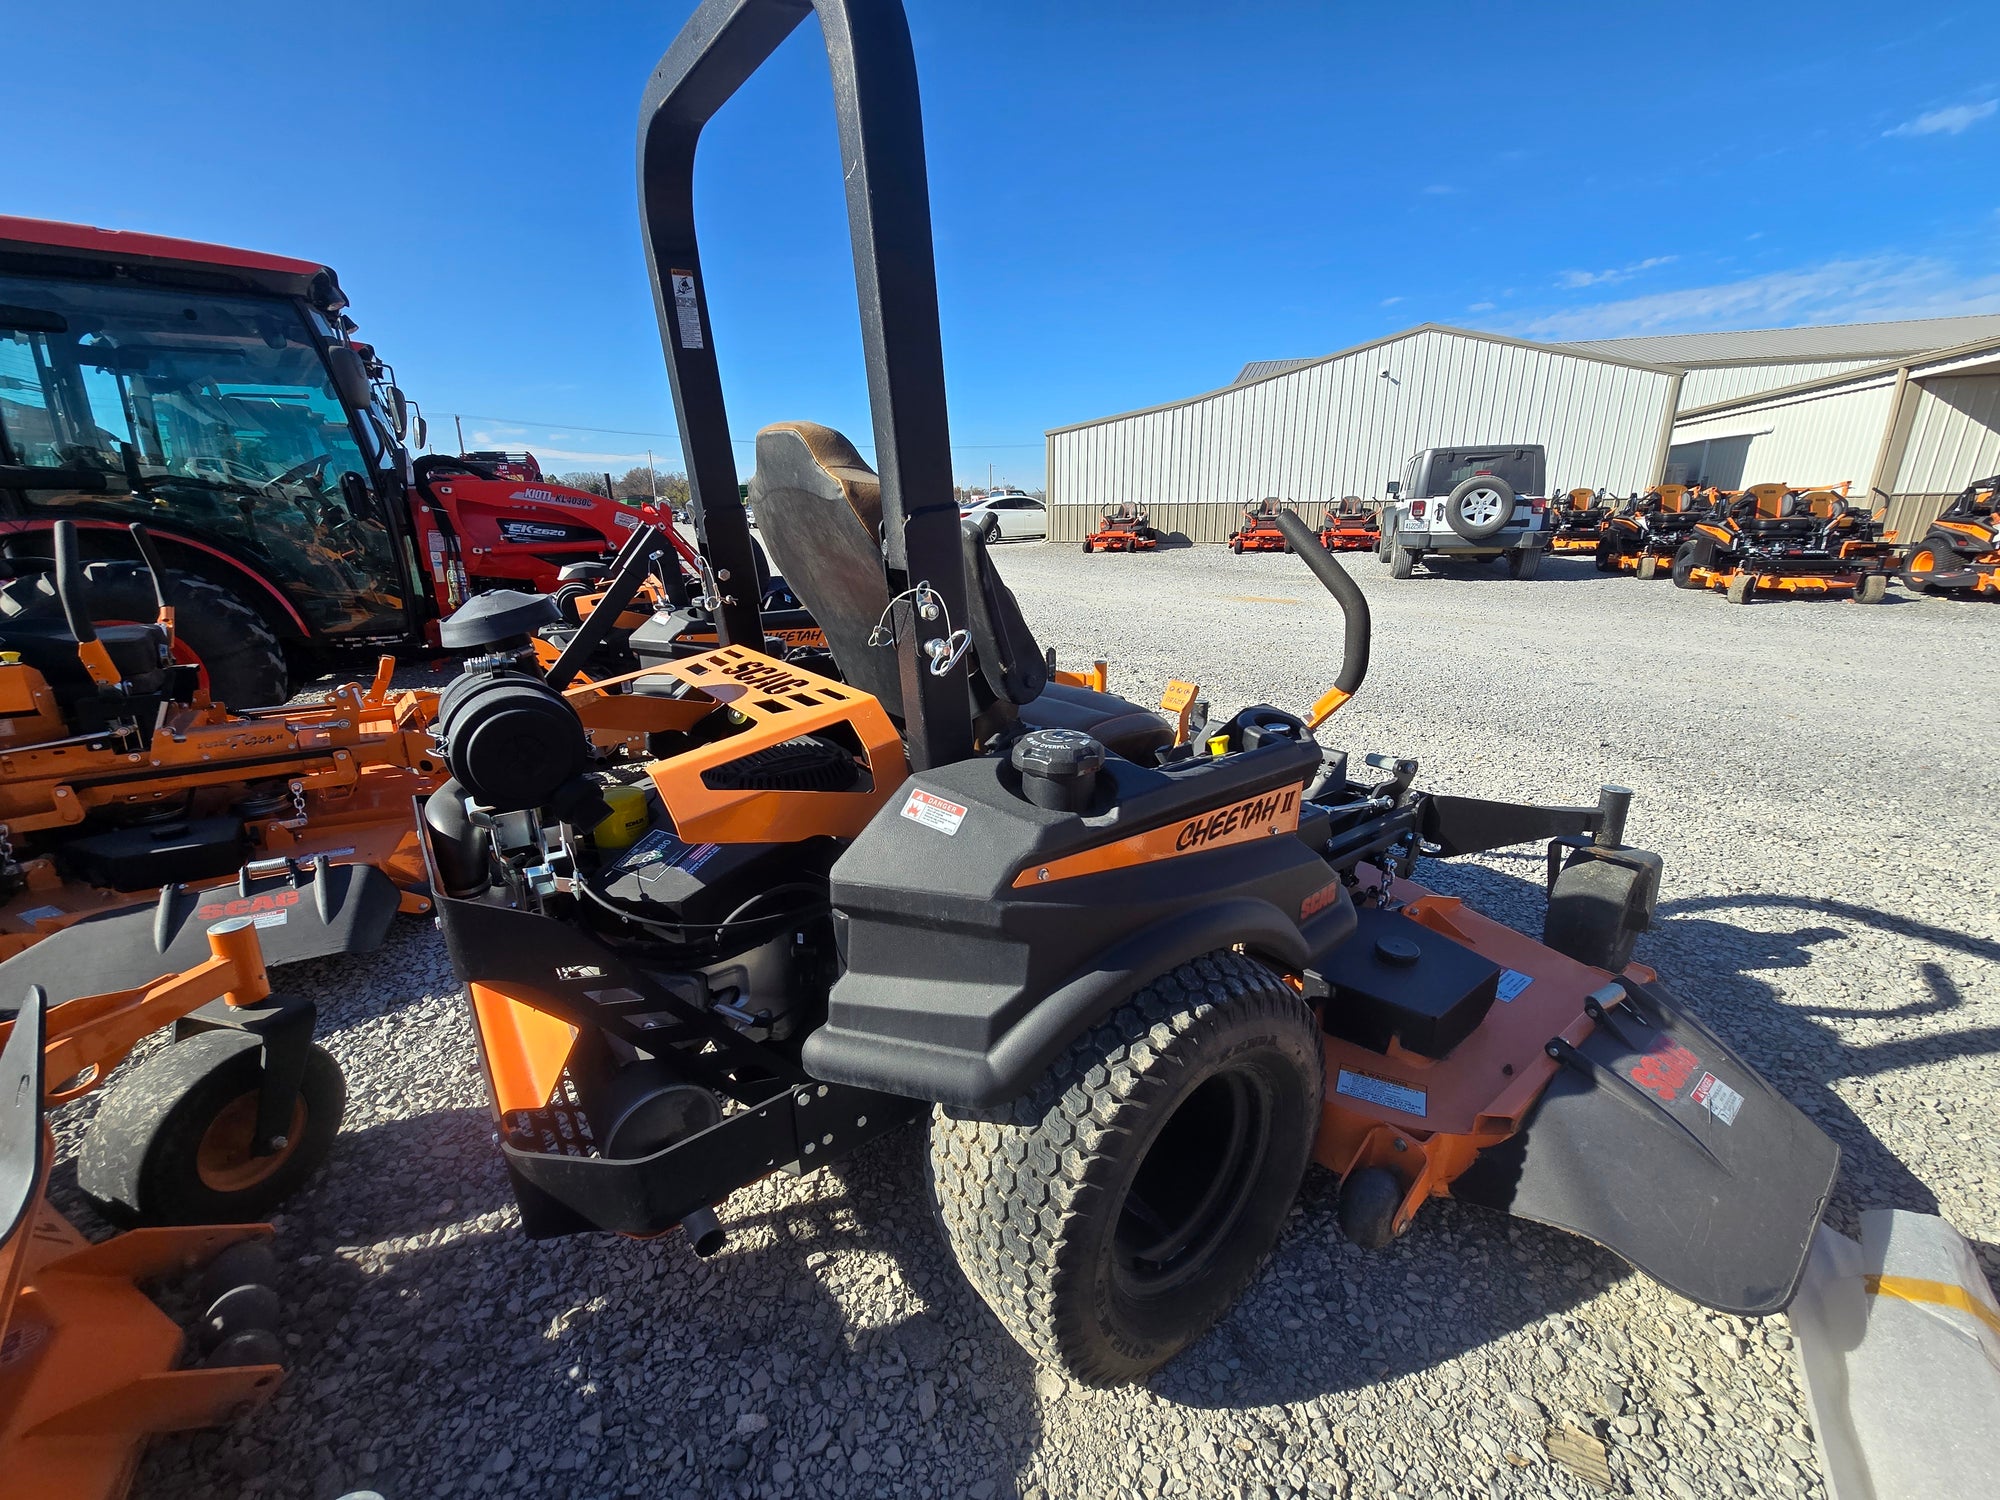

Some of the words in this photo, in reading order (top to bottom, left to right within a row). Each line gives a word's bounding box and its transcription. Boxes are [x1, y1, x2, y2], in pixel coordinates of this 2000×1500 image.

[525, 488, 551, 502] KIOTI
[721, 661, 809, 694] SCAG
[927, 797, 957, 813] DANGER
[1175, 792, 1282, 851] CHEETAH
[1280, 790, 1296, 814] II
[197, 891, 299, 919] SCAG
[1367, 1072, 1408, 1088] WARNING
